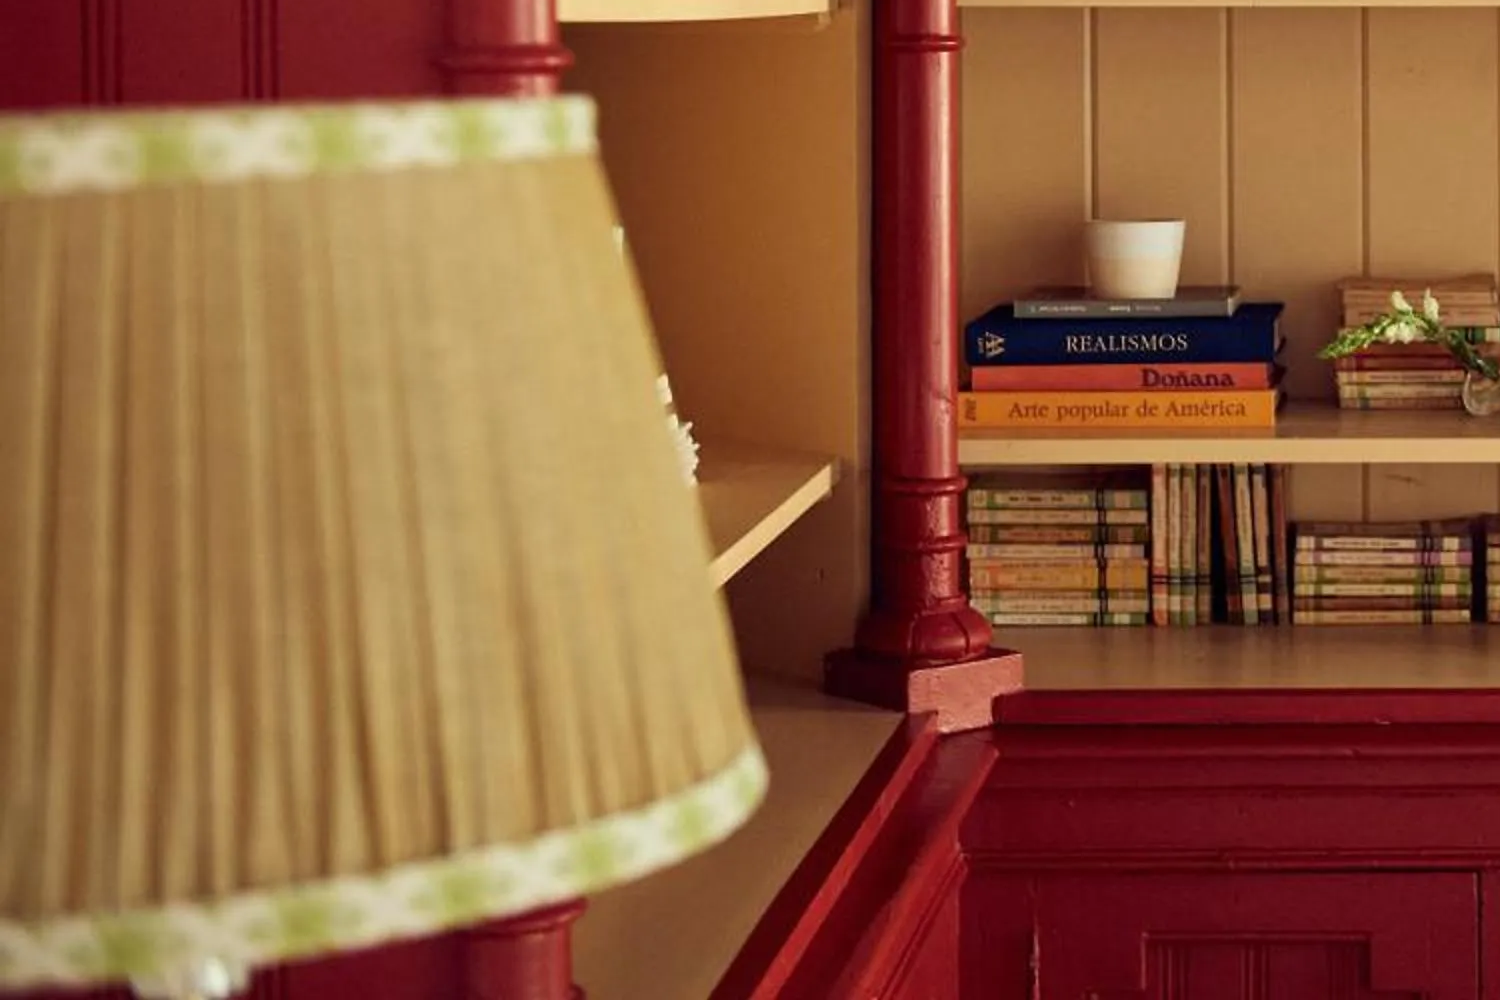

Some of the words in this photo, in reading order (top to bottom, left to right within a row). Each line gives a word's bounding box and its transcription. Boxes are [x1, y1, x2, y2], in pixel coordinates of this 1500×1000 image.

[1065, 334, 1188, 353] REALISMOS
[1141, 368, 1234, 387] Doñana
[1009, 401, 1049, 418] Arte
[1056, 401, 1128, 421] popular
[1136, 401, 1158, 418] de
[1165, 400, 1246, 418] América
